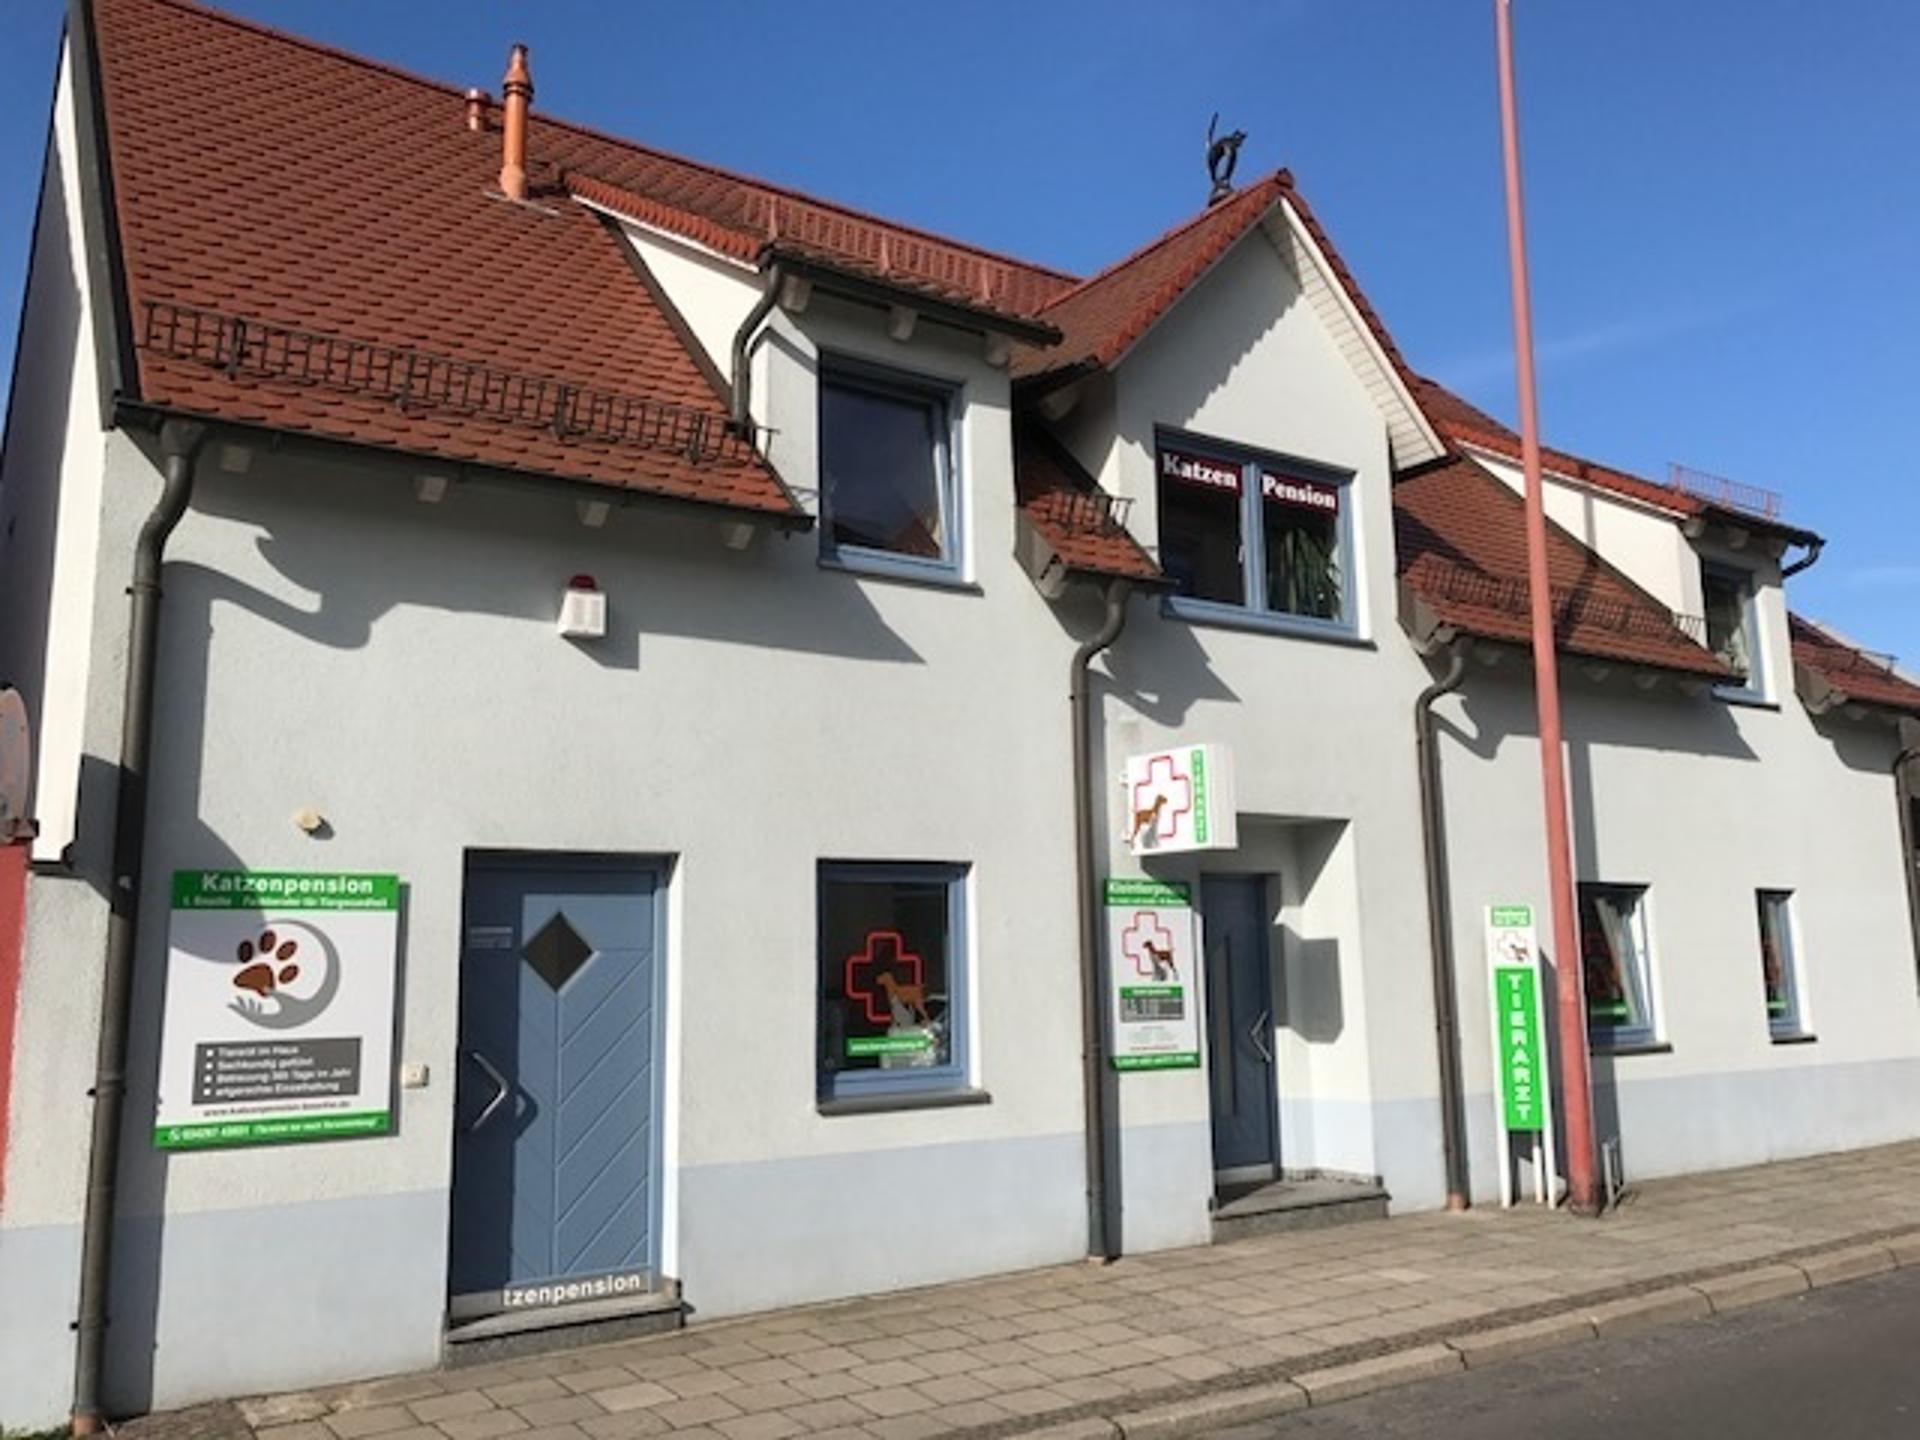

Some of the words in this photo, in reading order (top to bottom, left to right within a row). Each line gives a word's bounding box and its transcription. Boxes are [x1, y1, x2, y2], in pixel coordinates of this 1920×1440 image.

[1163, 454, 1238, 488] Katzen
[1261, 474, 1336, 509] Pension
[202, 873, 374, 894] Katzenpension
[273, 1046, 299, 1055] Haus
[1508, 973, 1533, 1122] TIERARZT
[218, 1061, 276, 1072] Sachkundig
[292, 1070, 315, 1081] Tage
[331, 1067, 351, 1077] Jahr
